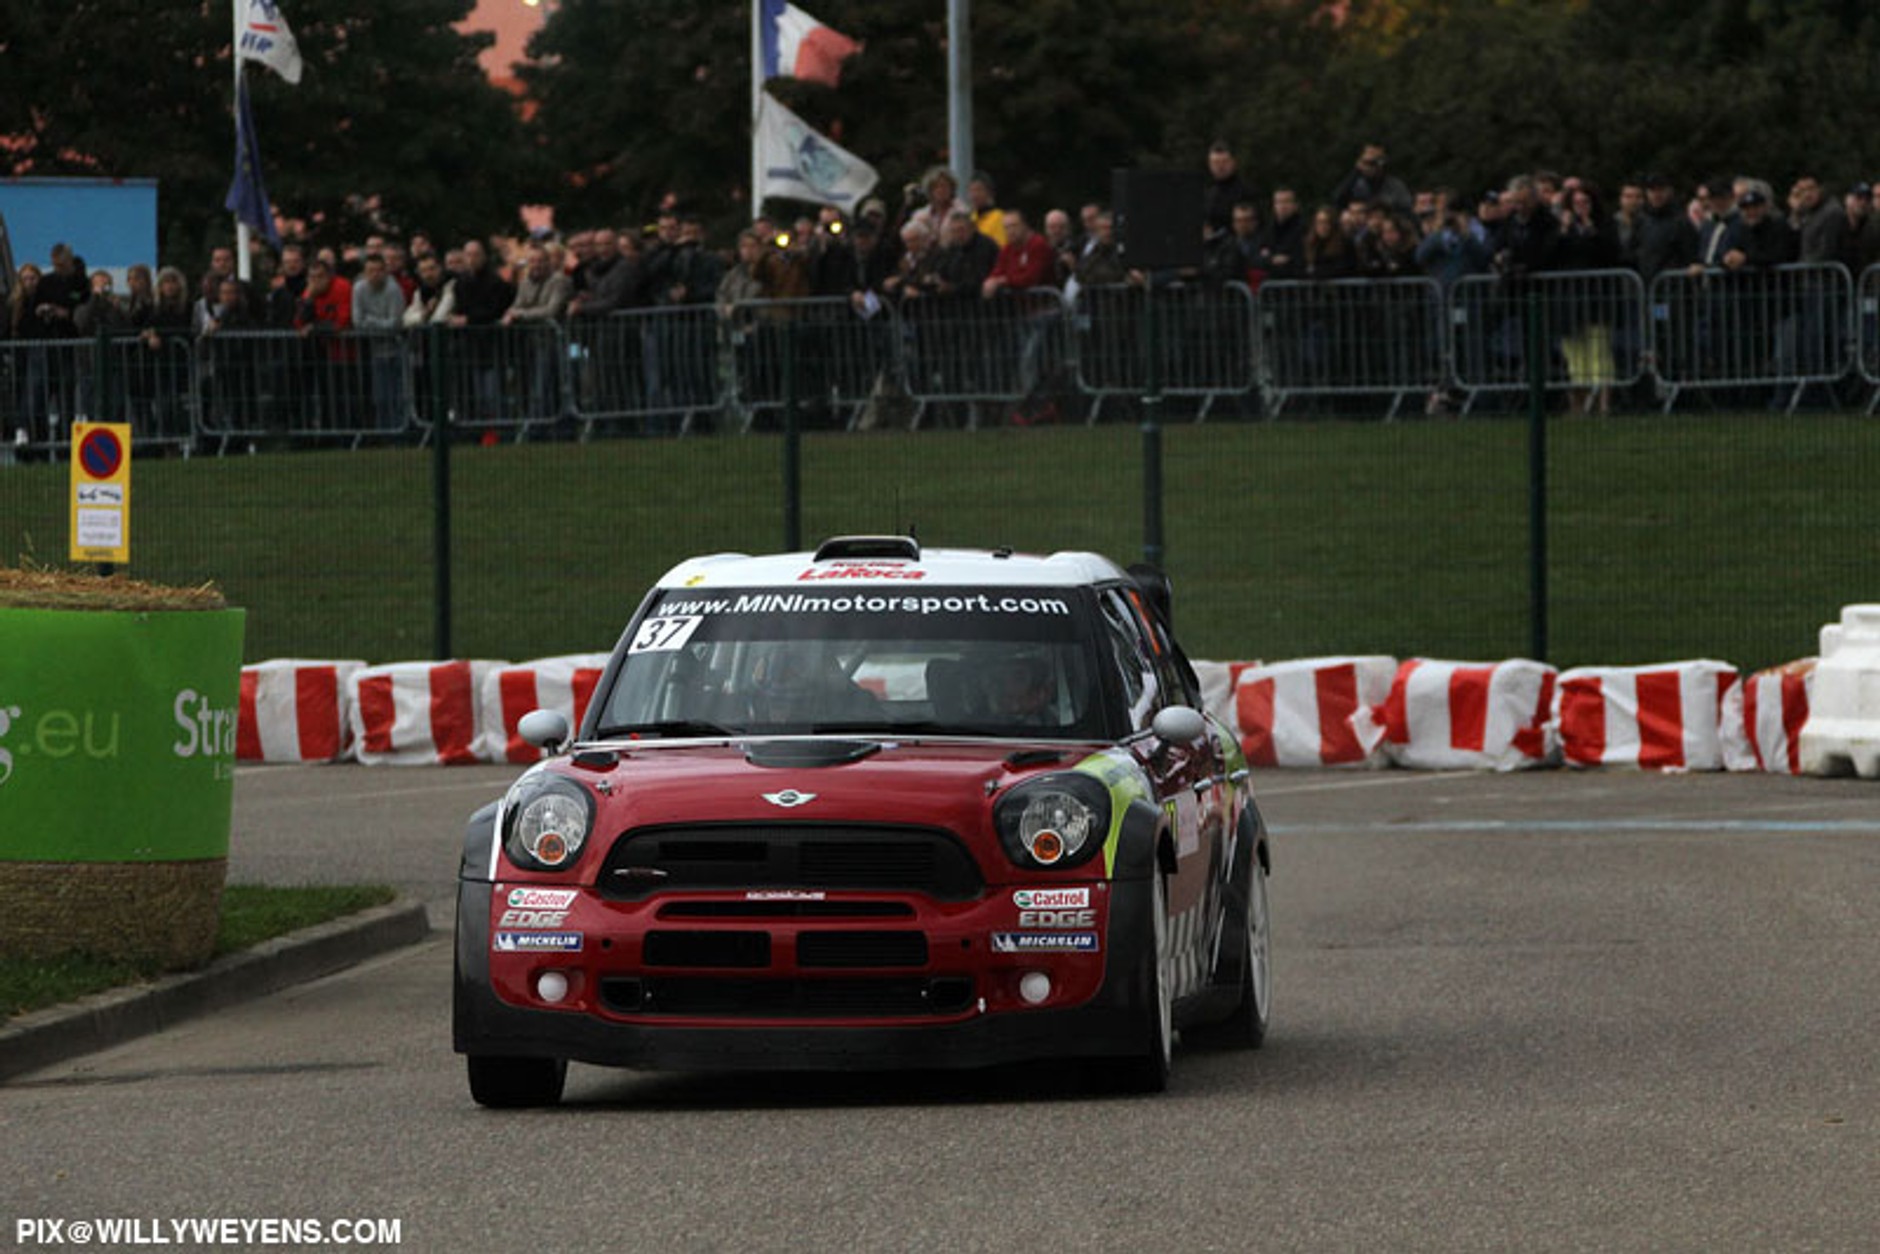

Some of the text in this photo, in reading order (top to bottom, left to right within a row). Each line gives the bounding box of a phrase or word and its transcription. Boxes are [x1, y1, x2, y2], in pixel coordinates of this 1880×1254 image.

[657, 594, 1069, 616] www.MINImotorsport.com
[636, 619, 691, 650] 37
[1032, 891, 1085, 906] Castrol
[499, 909, 571, 928] EDGE
[1019, 908, 1097, 928] EDGE
[517, 935, 578, 947] MICHELIN
[1018, 935, 1093, 947] MICHELIN
